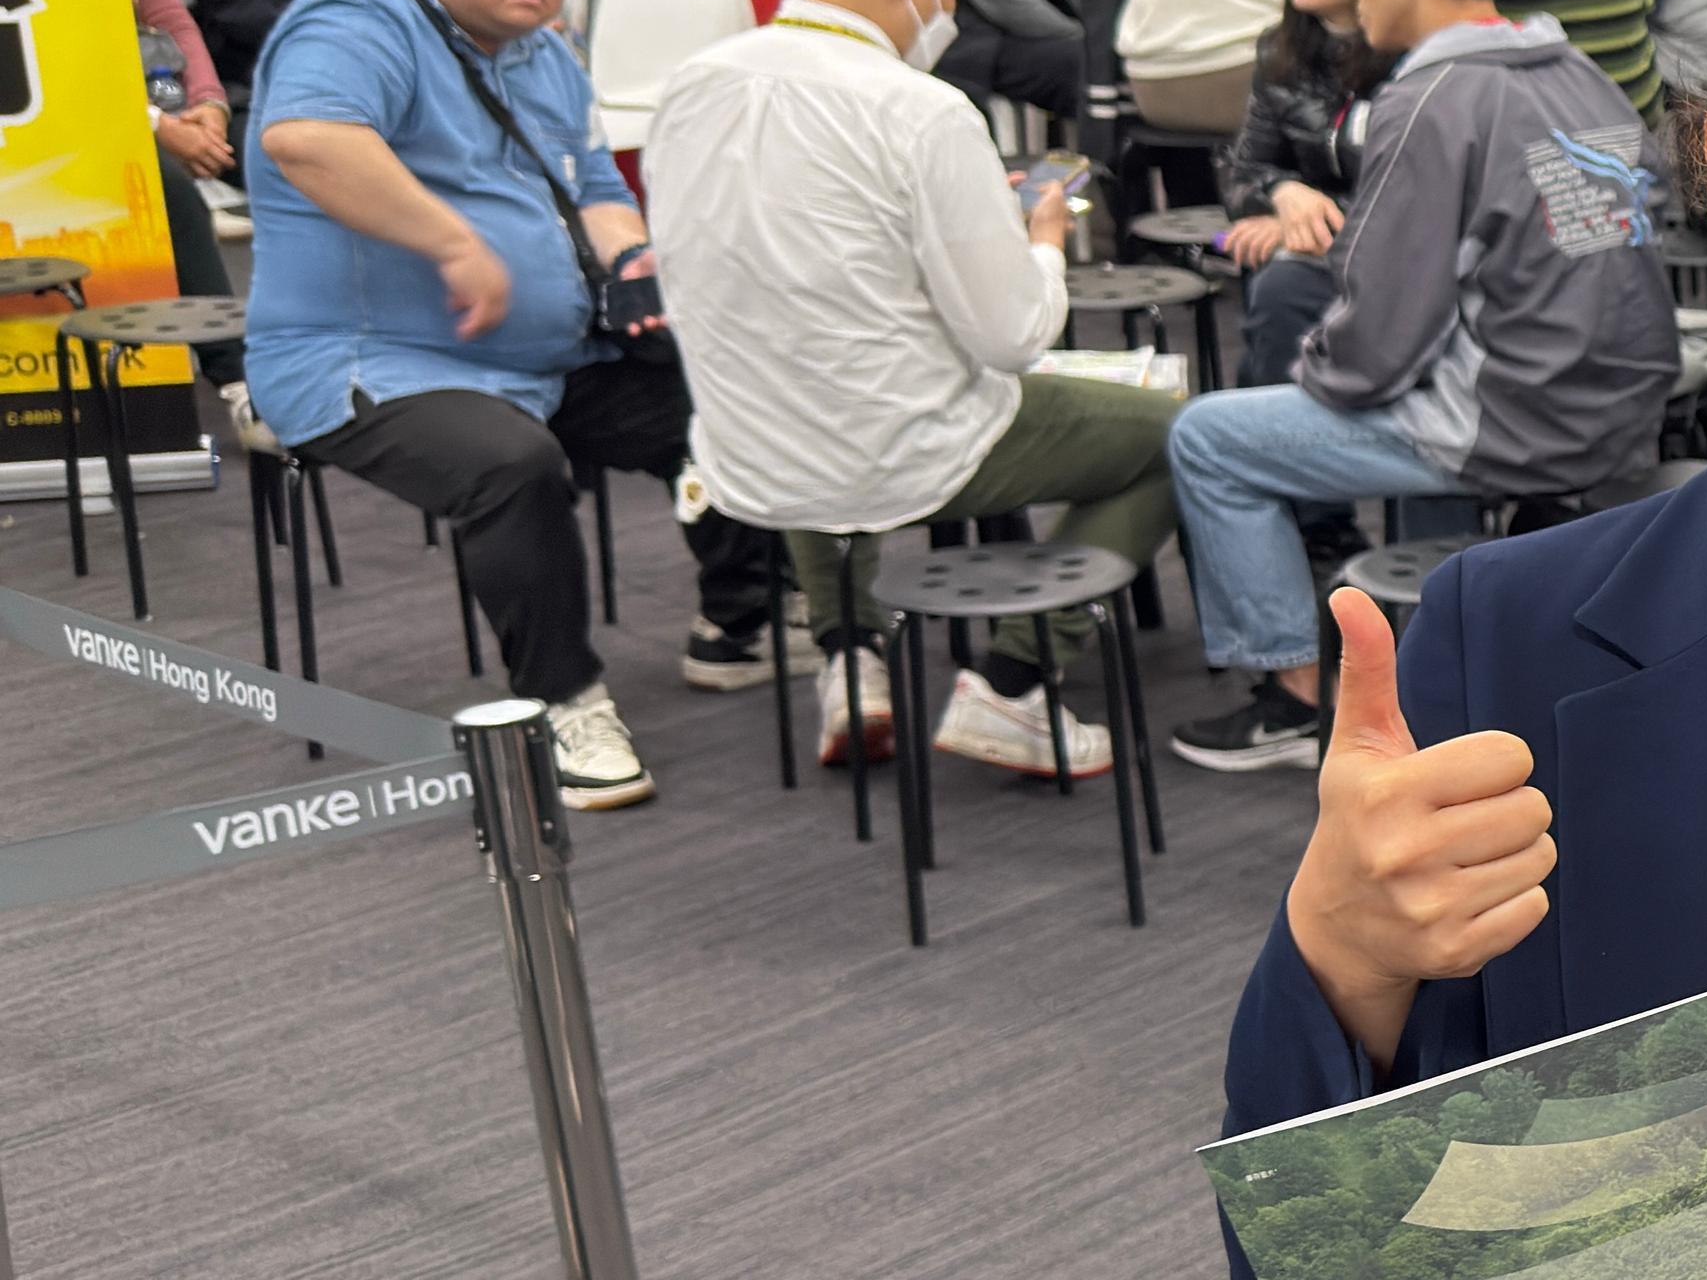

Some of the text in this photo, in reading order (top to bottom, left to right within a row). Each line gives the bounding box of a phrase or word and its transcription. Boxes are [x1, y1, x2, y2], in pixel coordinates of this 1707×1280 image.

[64, 623, 277, 721] vanke Hong Kong
[193, 769, 475, 856] vanke Hon
